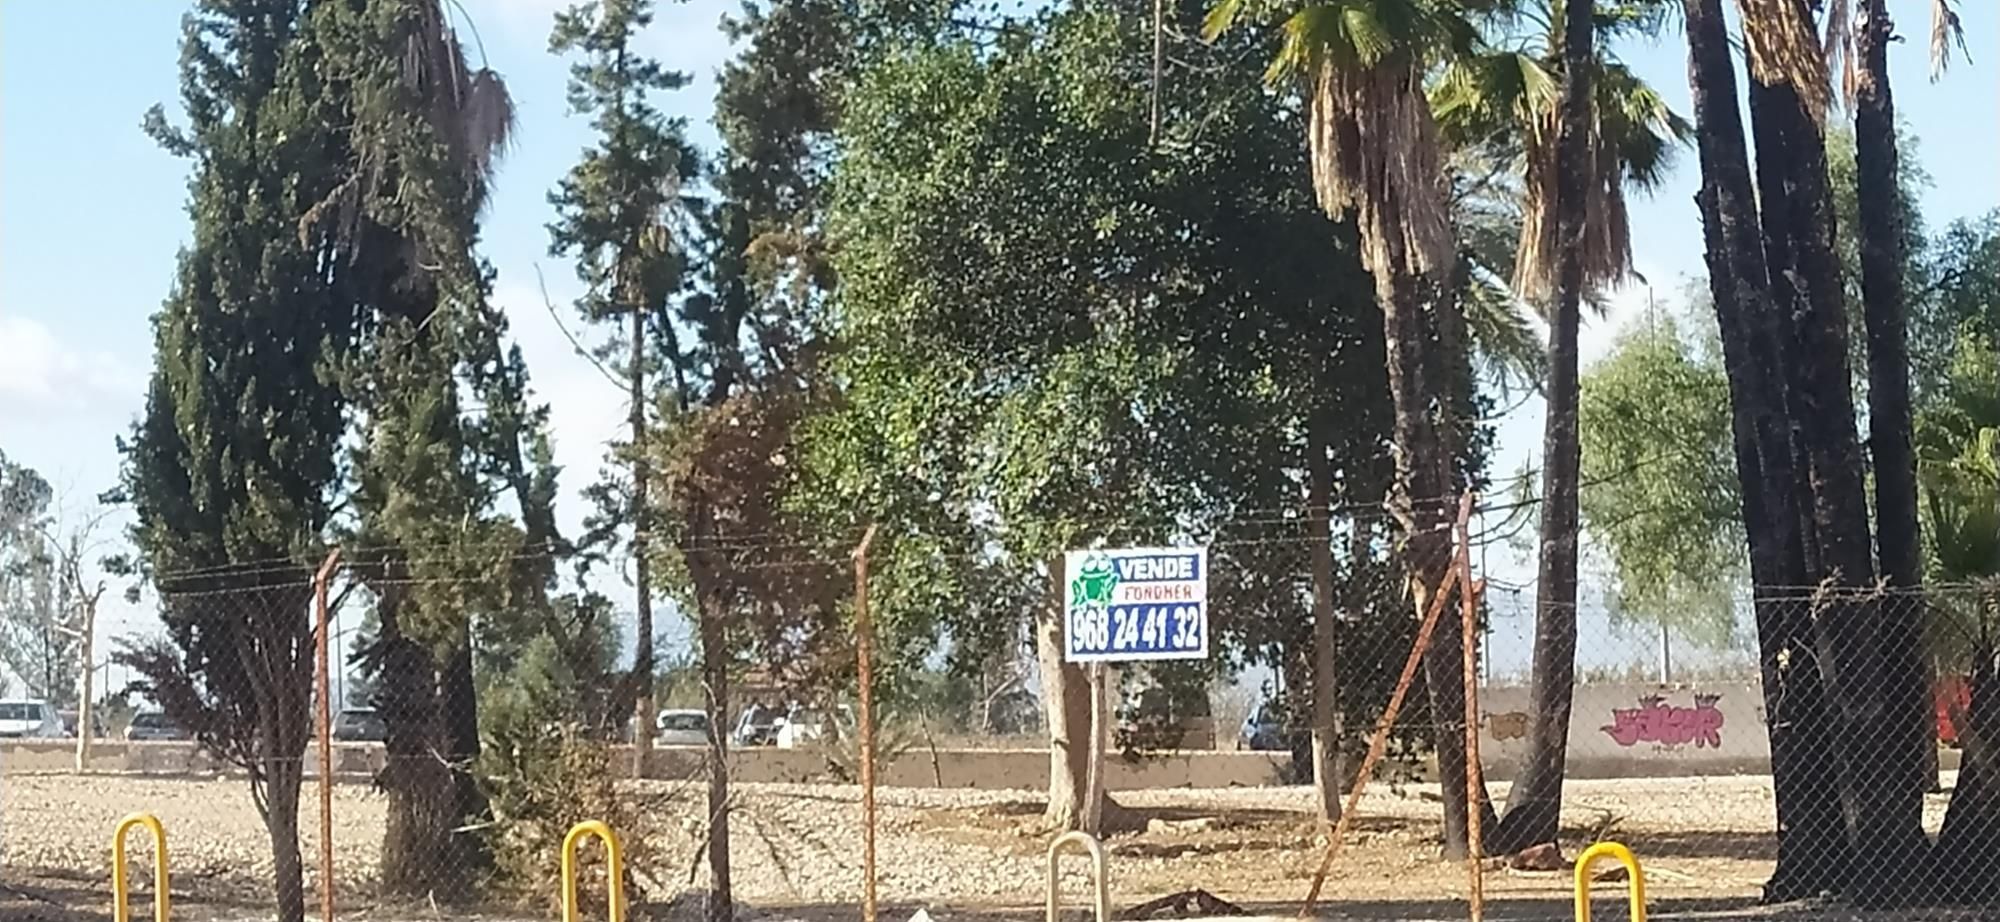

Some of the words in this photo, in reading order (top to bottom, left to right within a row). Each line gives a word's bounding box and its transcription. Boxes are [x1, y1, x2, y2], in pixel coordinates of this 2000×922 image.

[1118, 557, 1193, 580] VENDE
[1073, 608, 1110, 652] 968
[1113, 607, 1139, 650] 24
[1142, 606, 1168, 649] 41
[1172, 605, 1199, 648] 32
